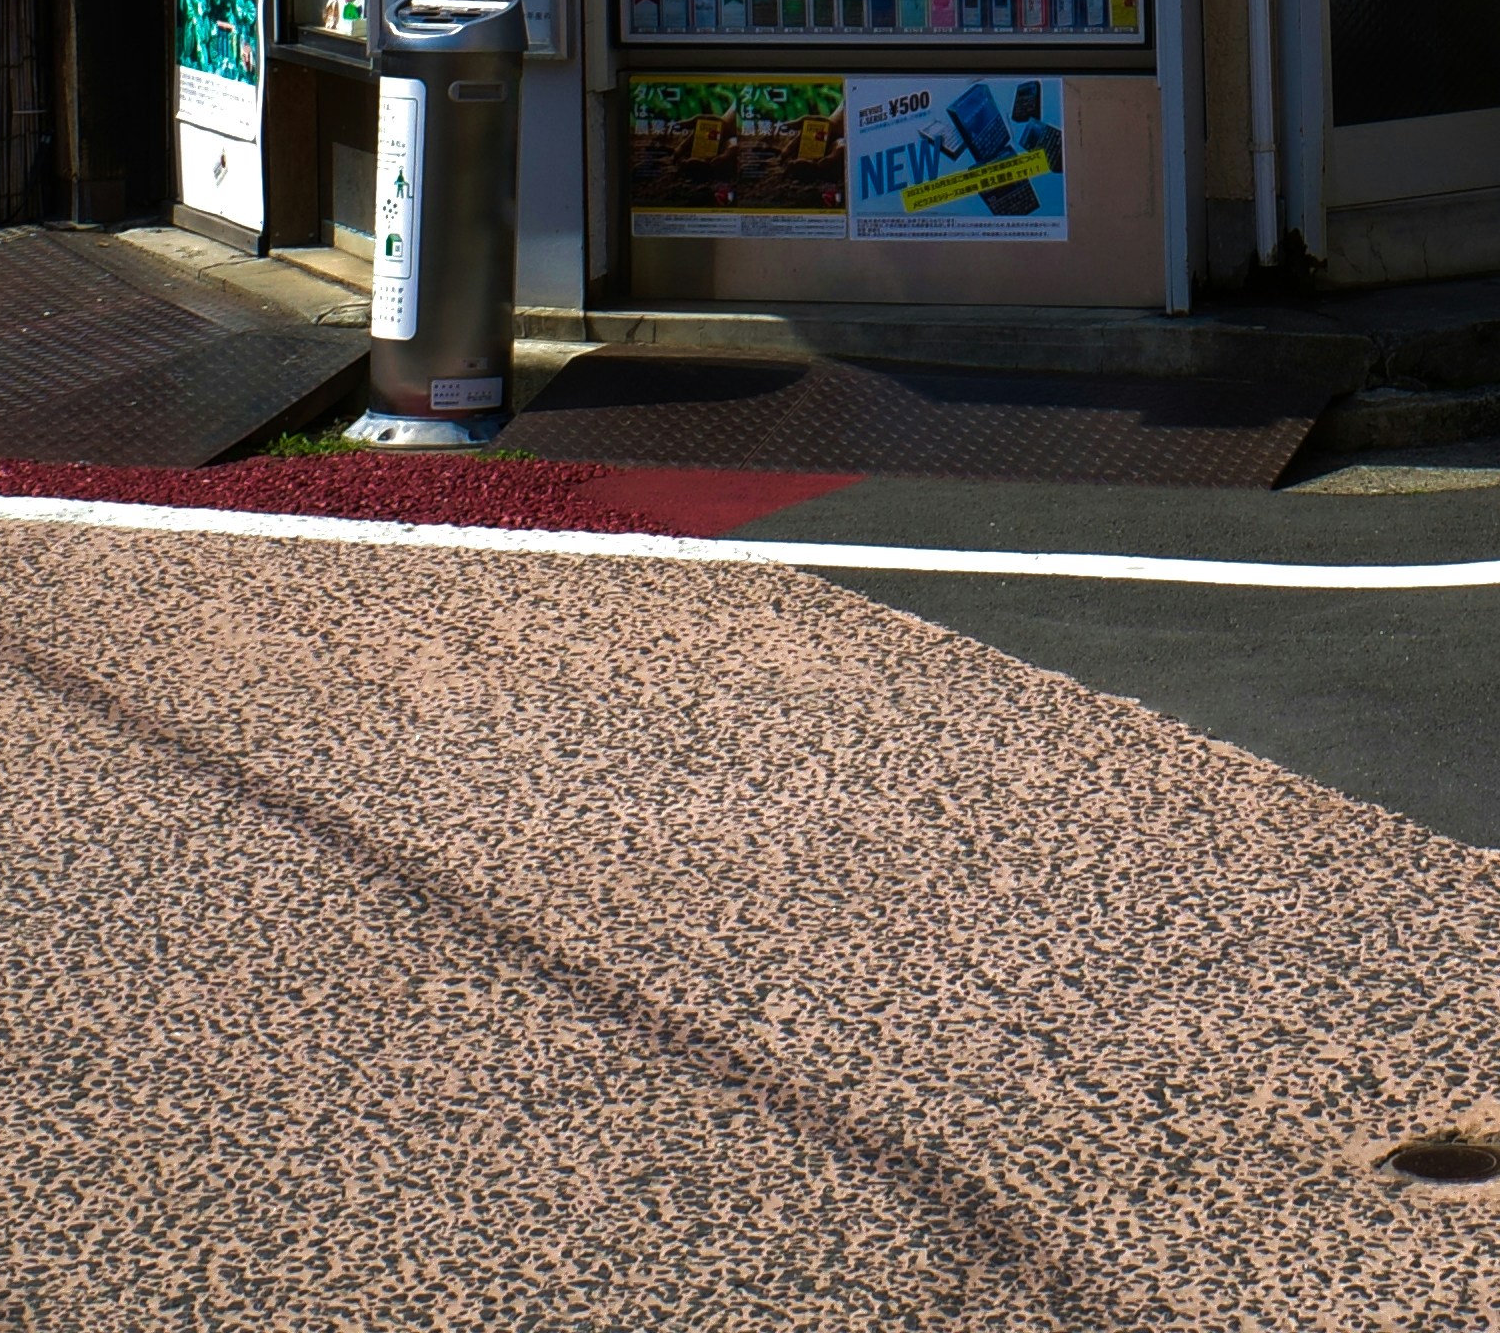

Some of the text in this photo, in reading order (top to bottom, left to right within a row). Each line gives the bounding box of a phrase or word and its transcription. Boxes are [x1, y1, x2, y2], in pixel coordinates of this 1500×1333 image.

[634, 85, 682, 103] タバコ
[740, 85, 788, 103] タバコ
[889, 91, 931, 117] ¥500
[861, 134, 943, 201] NEW
